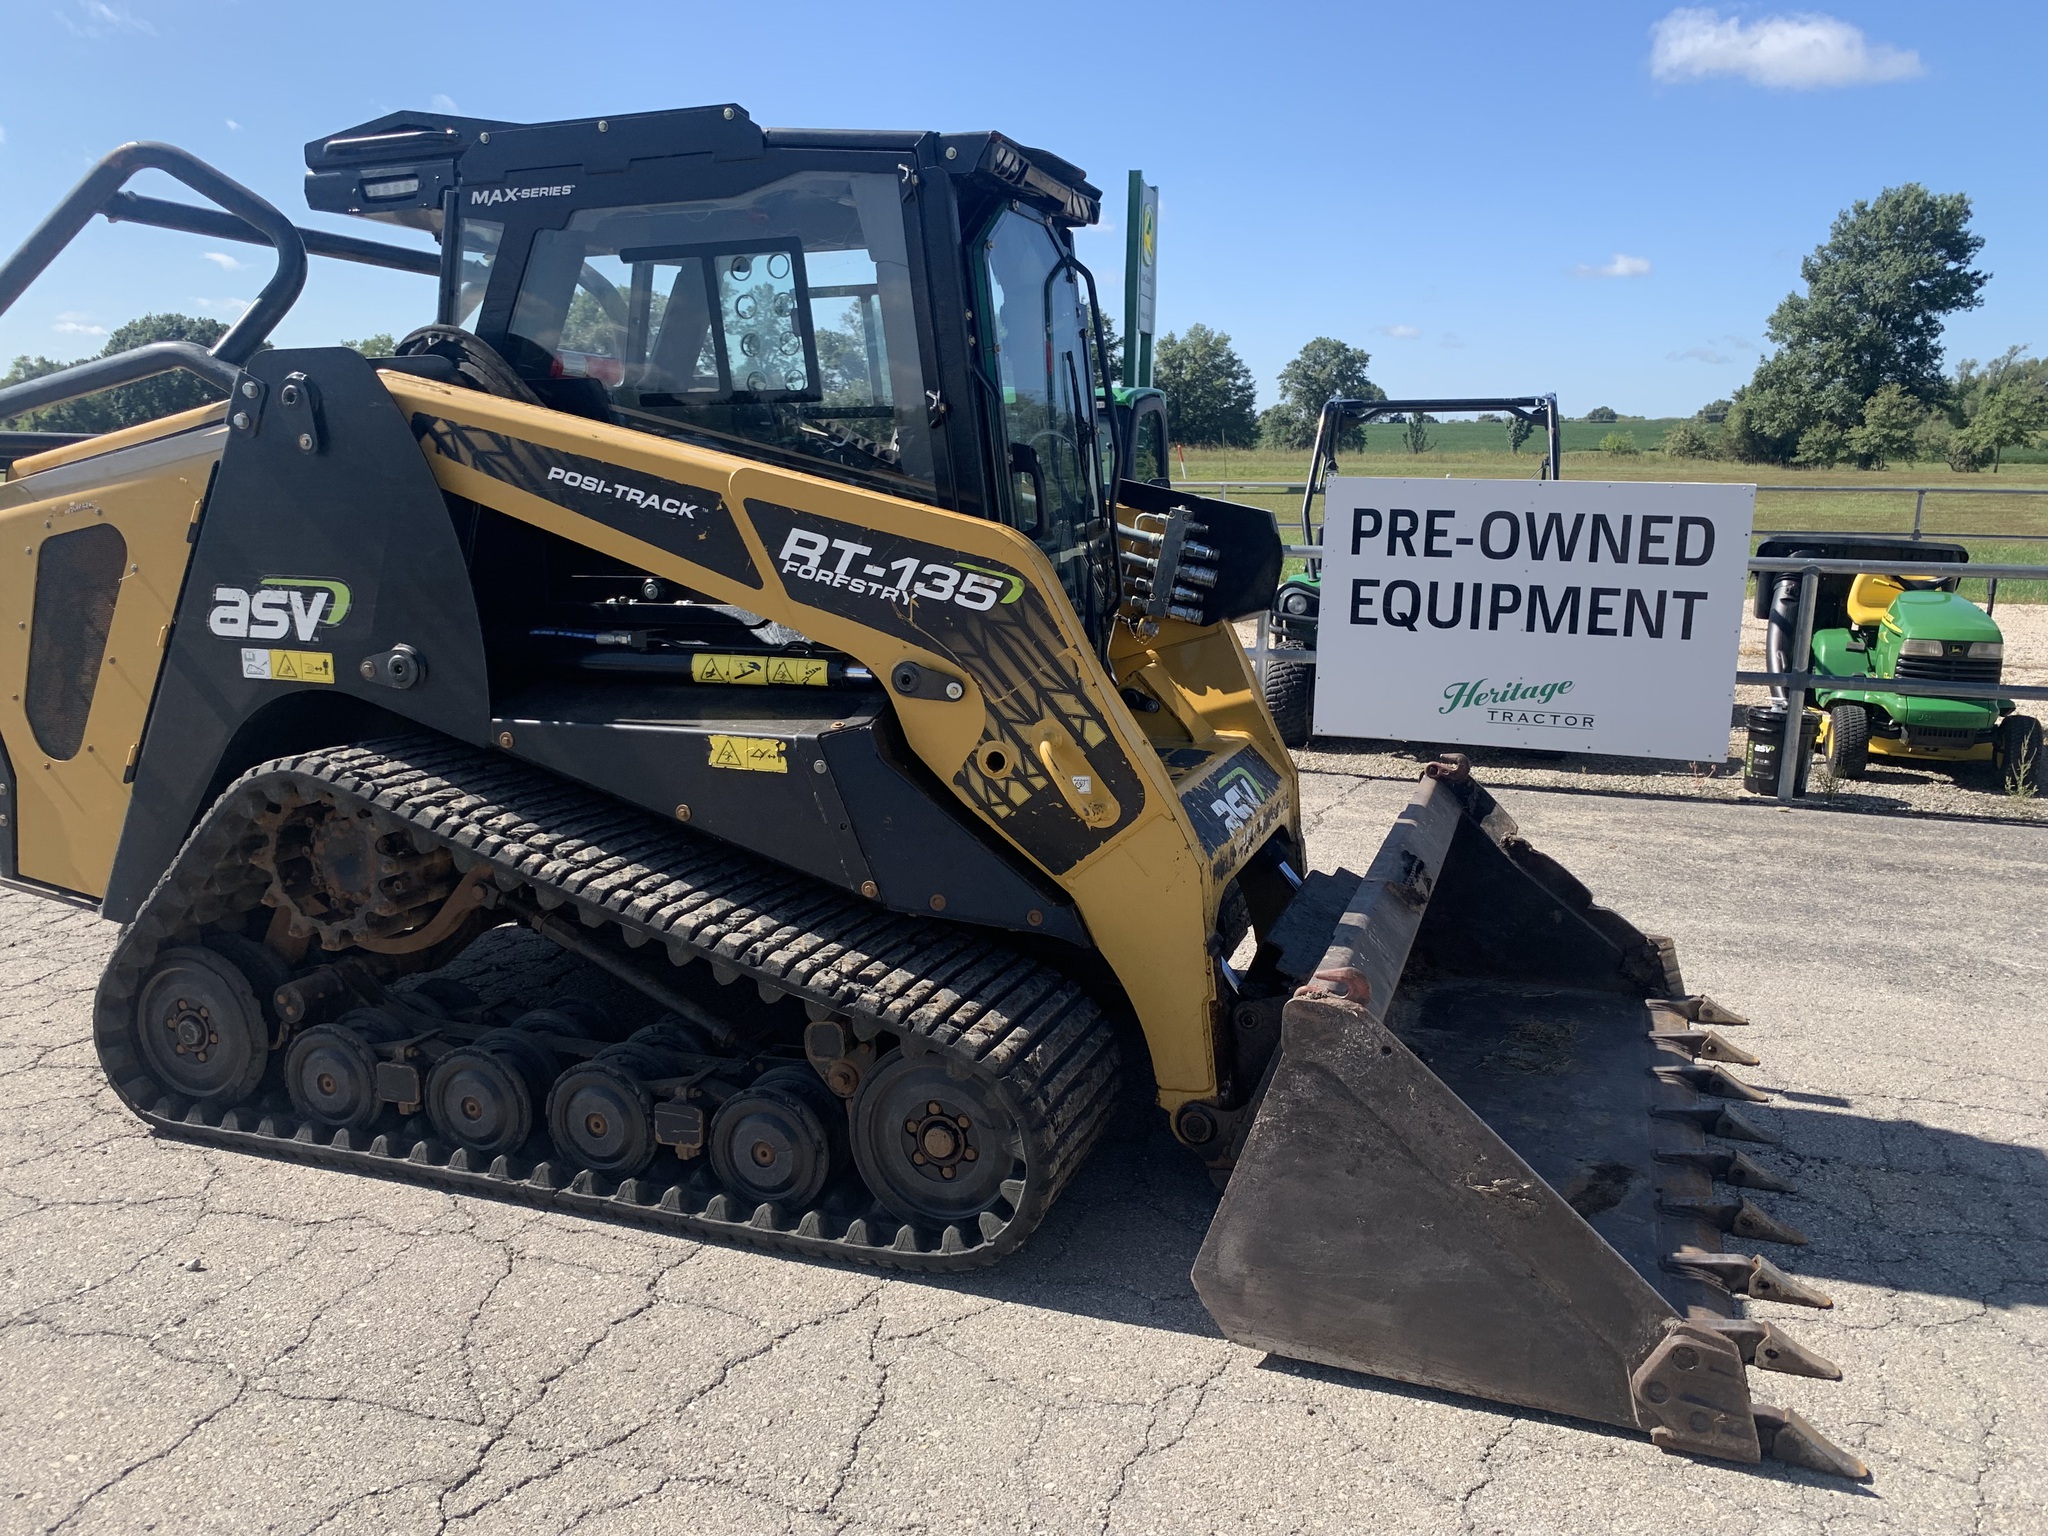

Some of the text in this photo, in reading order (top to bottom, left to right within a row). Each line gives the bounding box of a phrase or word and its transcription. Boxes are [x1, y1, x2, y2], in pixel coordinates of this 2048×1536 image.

[471, 186, 572, 206] MAX-SERIES
[547, 466, 698, 519] POSI-TRACK
[1350, 508, 1715, 567] PRE-OWNED
[778, 527, 1003, 612] RT-135
[782, 560, 917, 606] FORESTRY
[1350, 578, 1708, 640] EQUIPMENT
[1438, 678, 1575, 715] Heritage
[1487, 710, 1594, 728] TRACTOR
